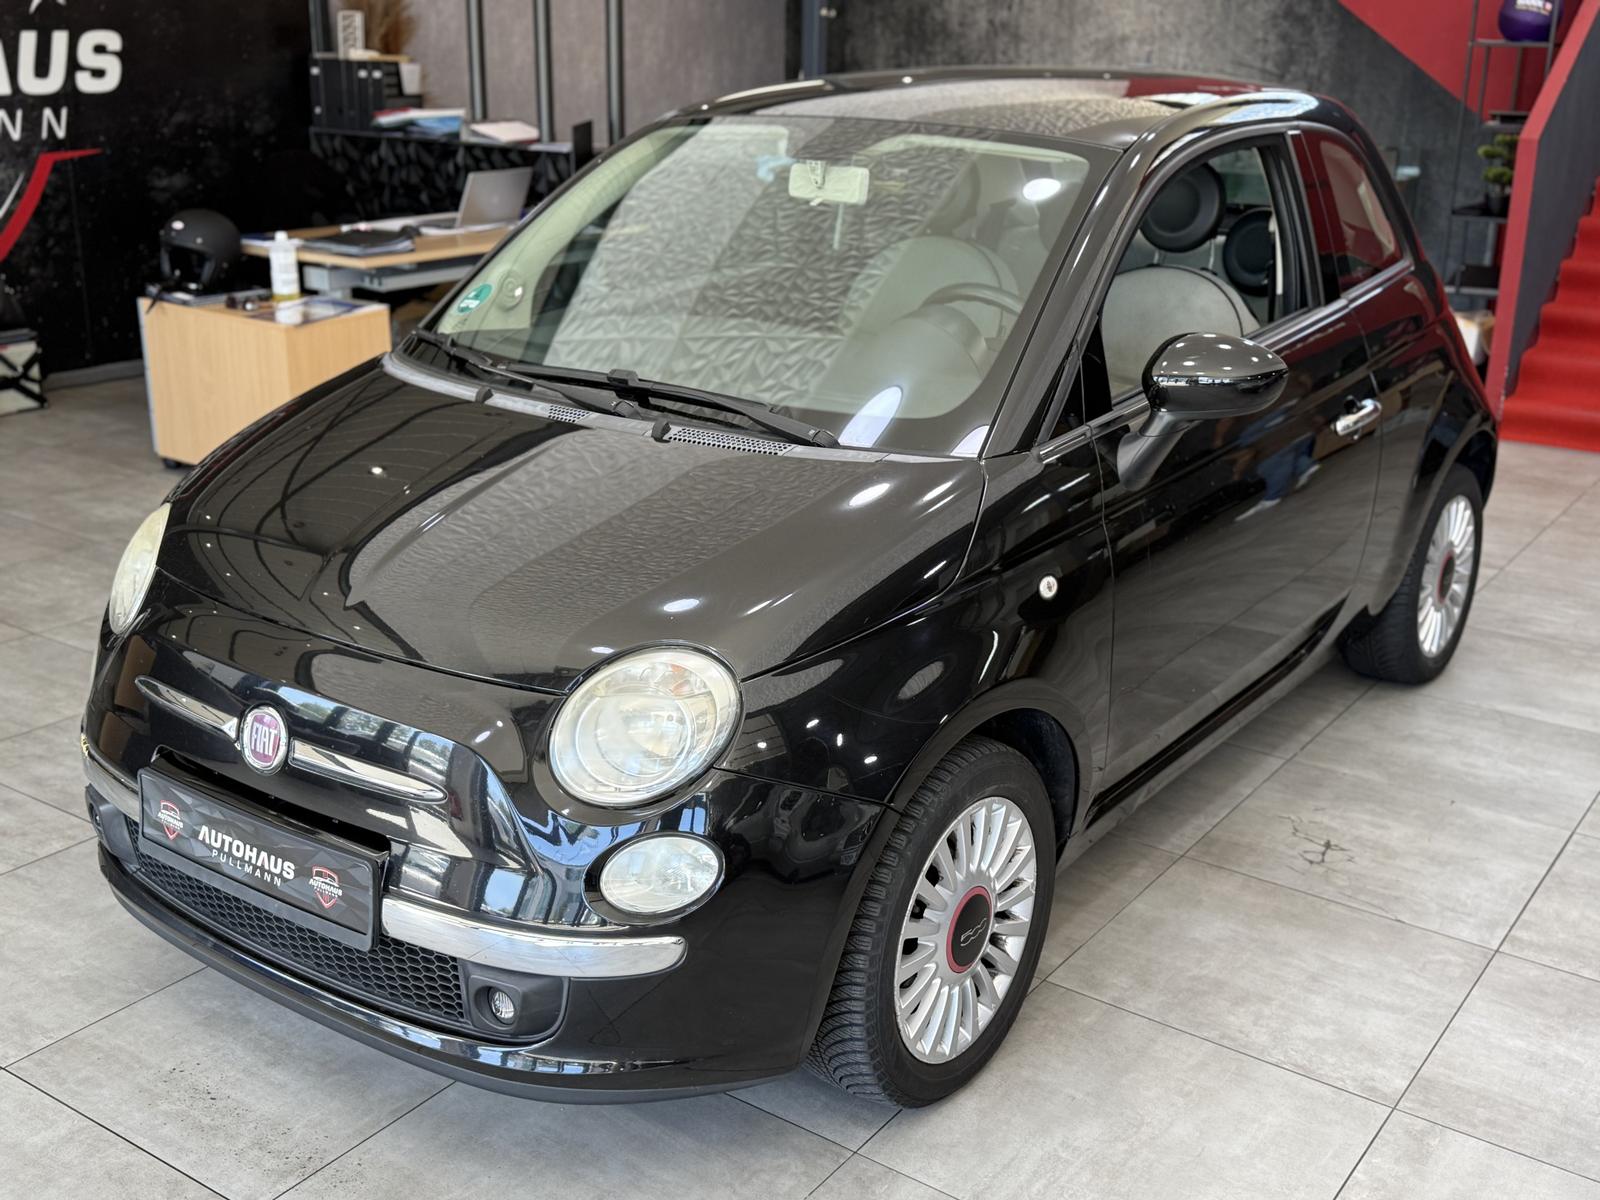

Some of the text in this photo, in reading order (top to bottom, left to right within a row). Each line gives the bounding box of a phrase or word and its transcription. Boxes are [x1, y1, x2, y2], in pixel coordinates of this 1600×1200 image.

[0, 29, 123, 96] US
[251, 721, 278, 756] FIAT
[198, 824, 296, 880] AUTOHAUS
[211, 849, 282, 887] PULLMANN
[308, 878, 343, 897] AUTOHAUS
